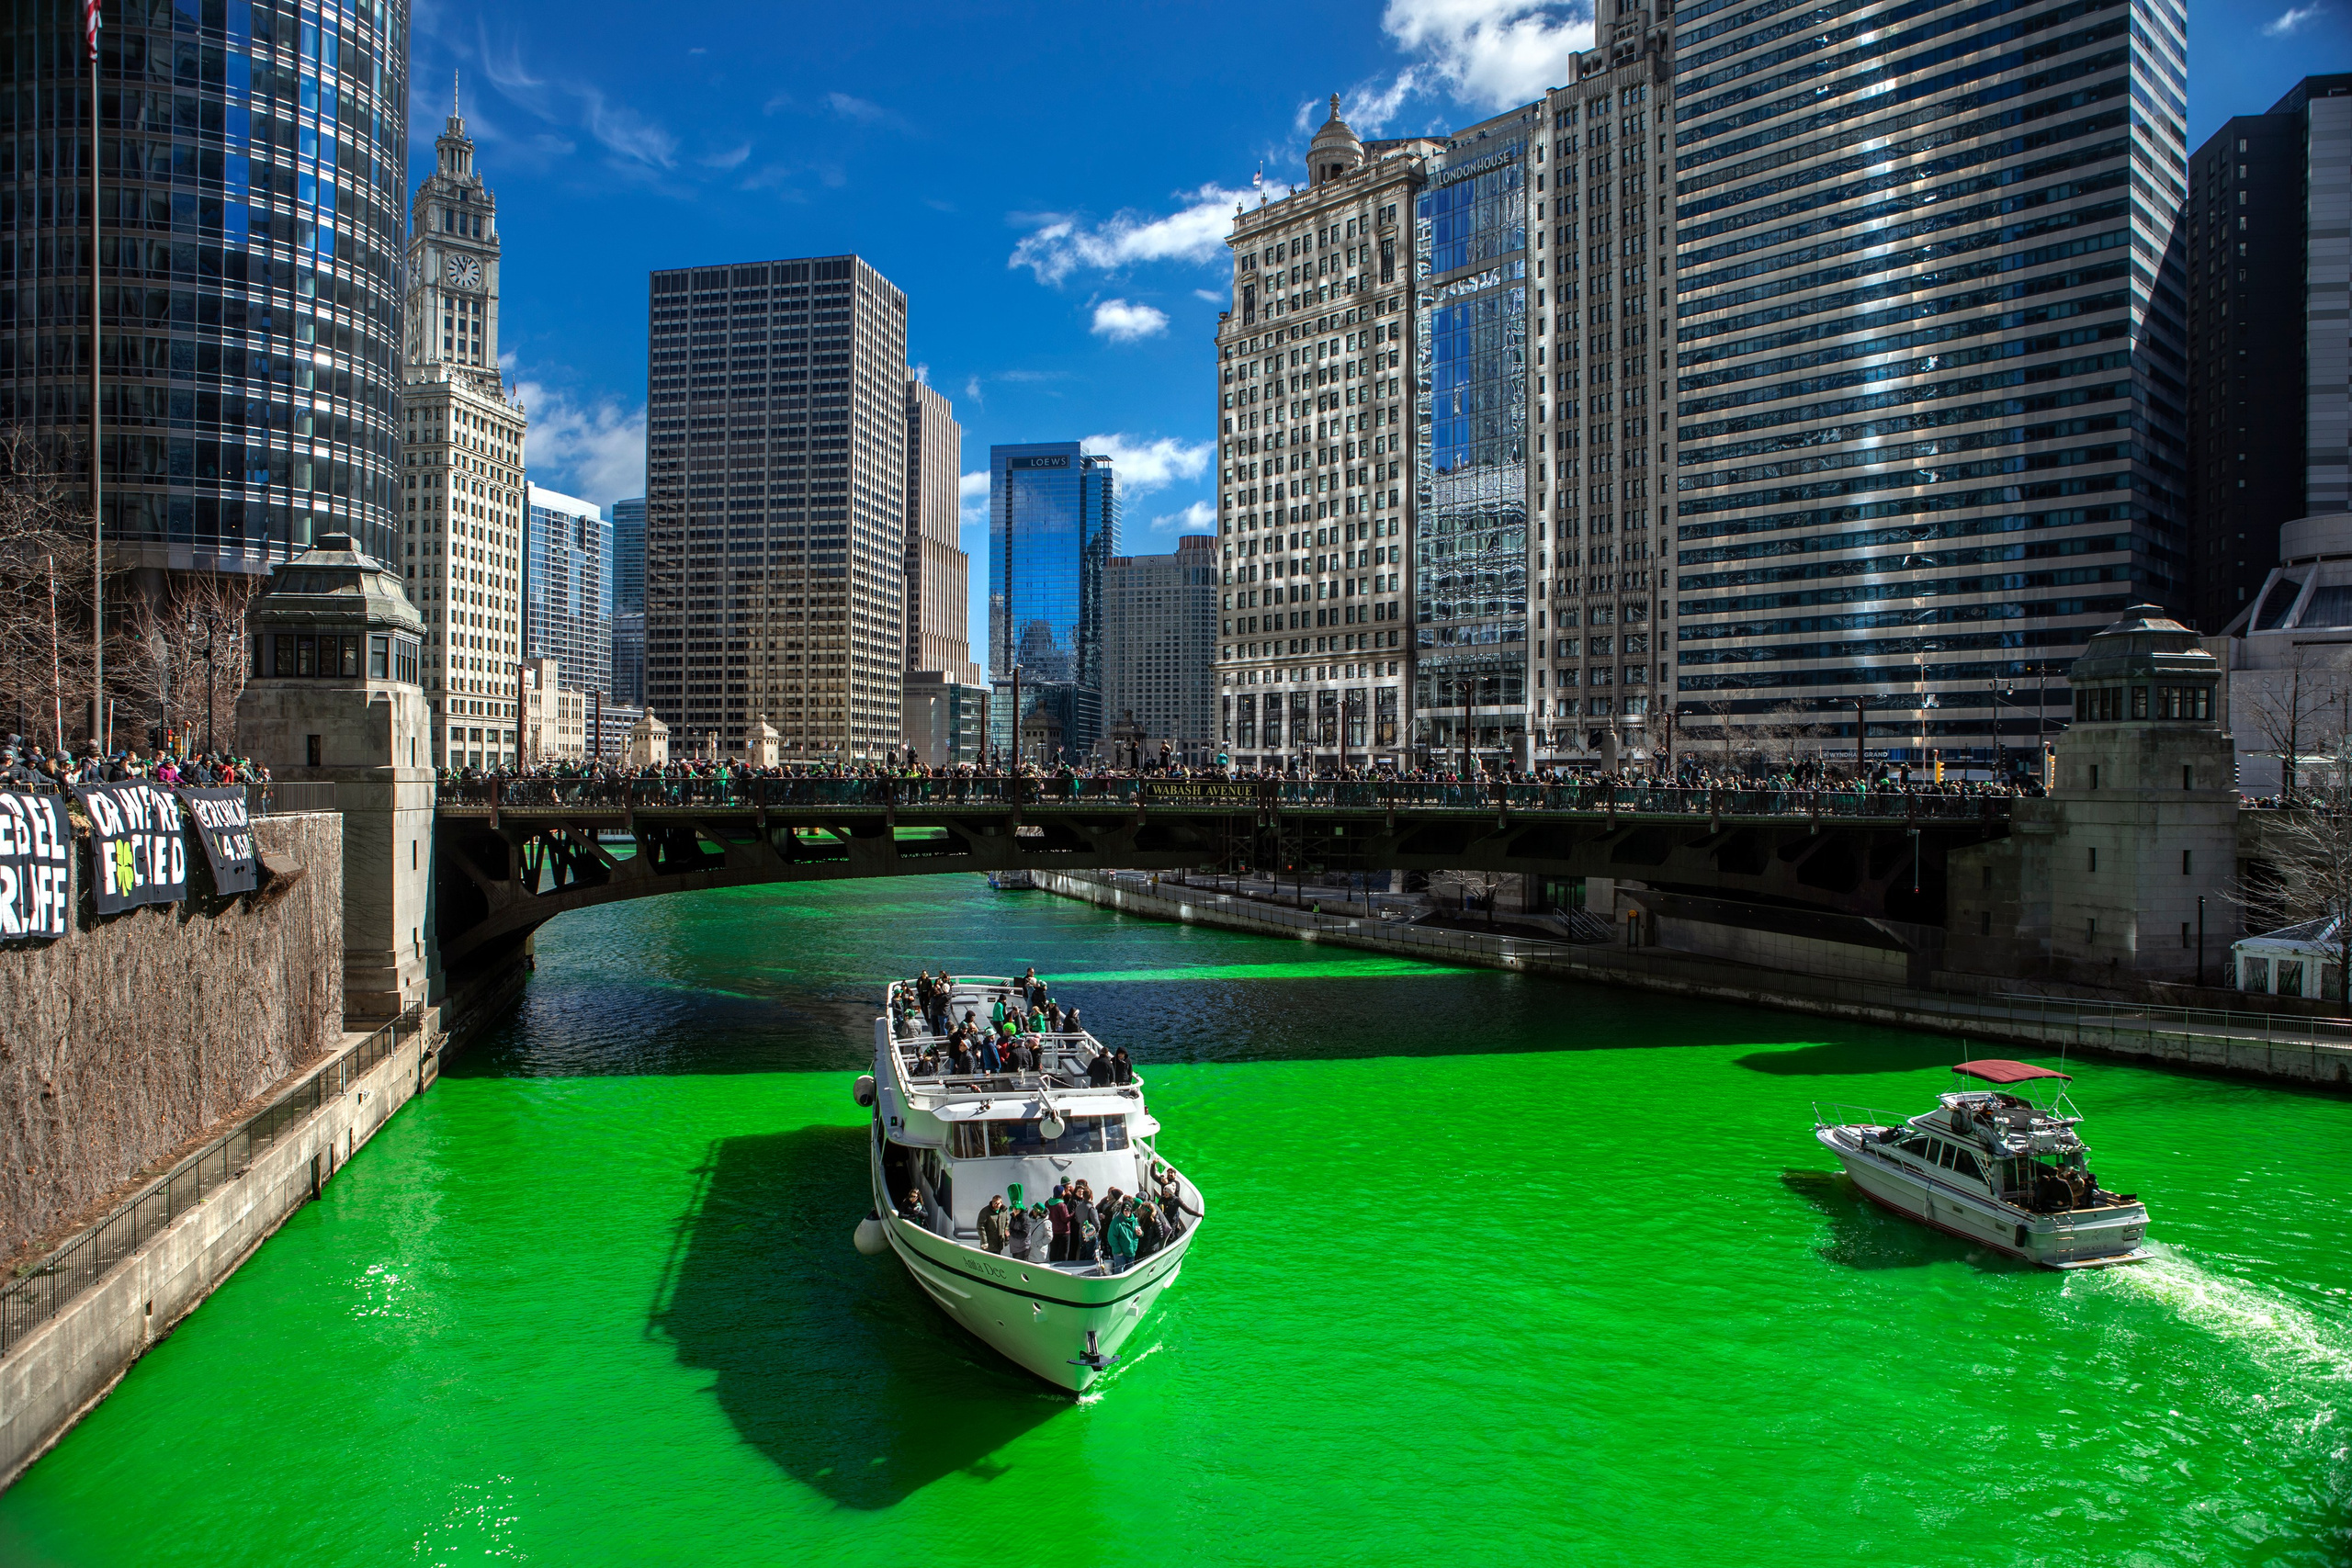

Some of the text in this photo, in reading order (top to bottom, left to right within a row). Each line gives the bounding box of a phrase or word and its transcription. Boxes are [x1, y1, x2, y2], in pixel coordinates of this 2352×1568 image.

[1438, 152, 1510, 185] LONDONHOUSE
[1031, 457, 1066, 467] LOEWS
[2262, 674, 2337, 689] SEVE
[1152, 784, 1252, 796] WABASH AVENUE
[112, 785, 181, 831] WE'RE
